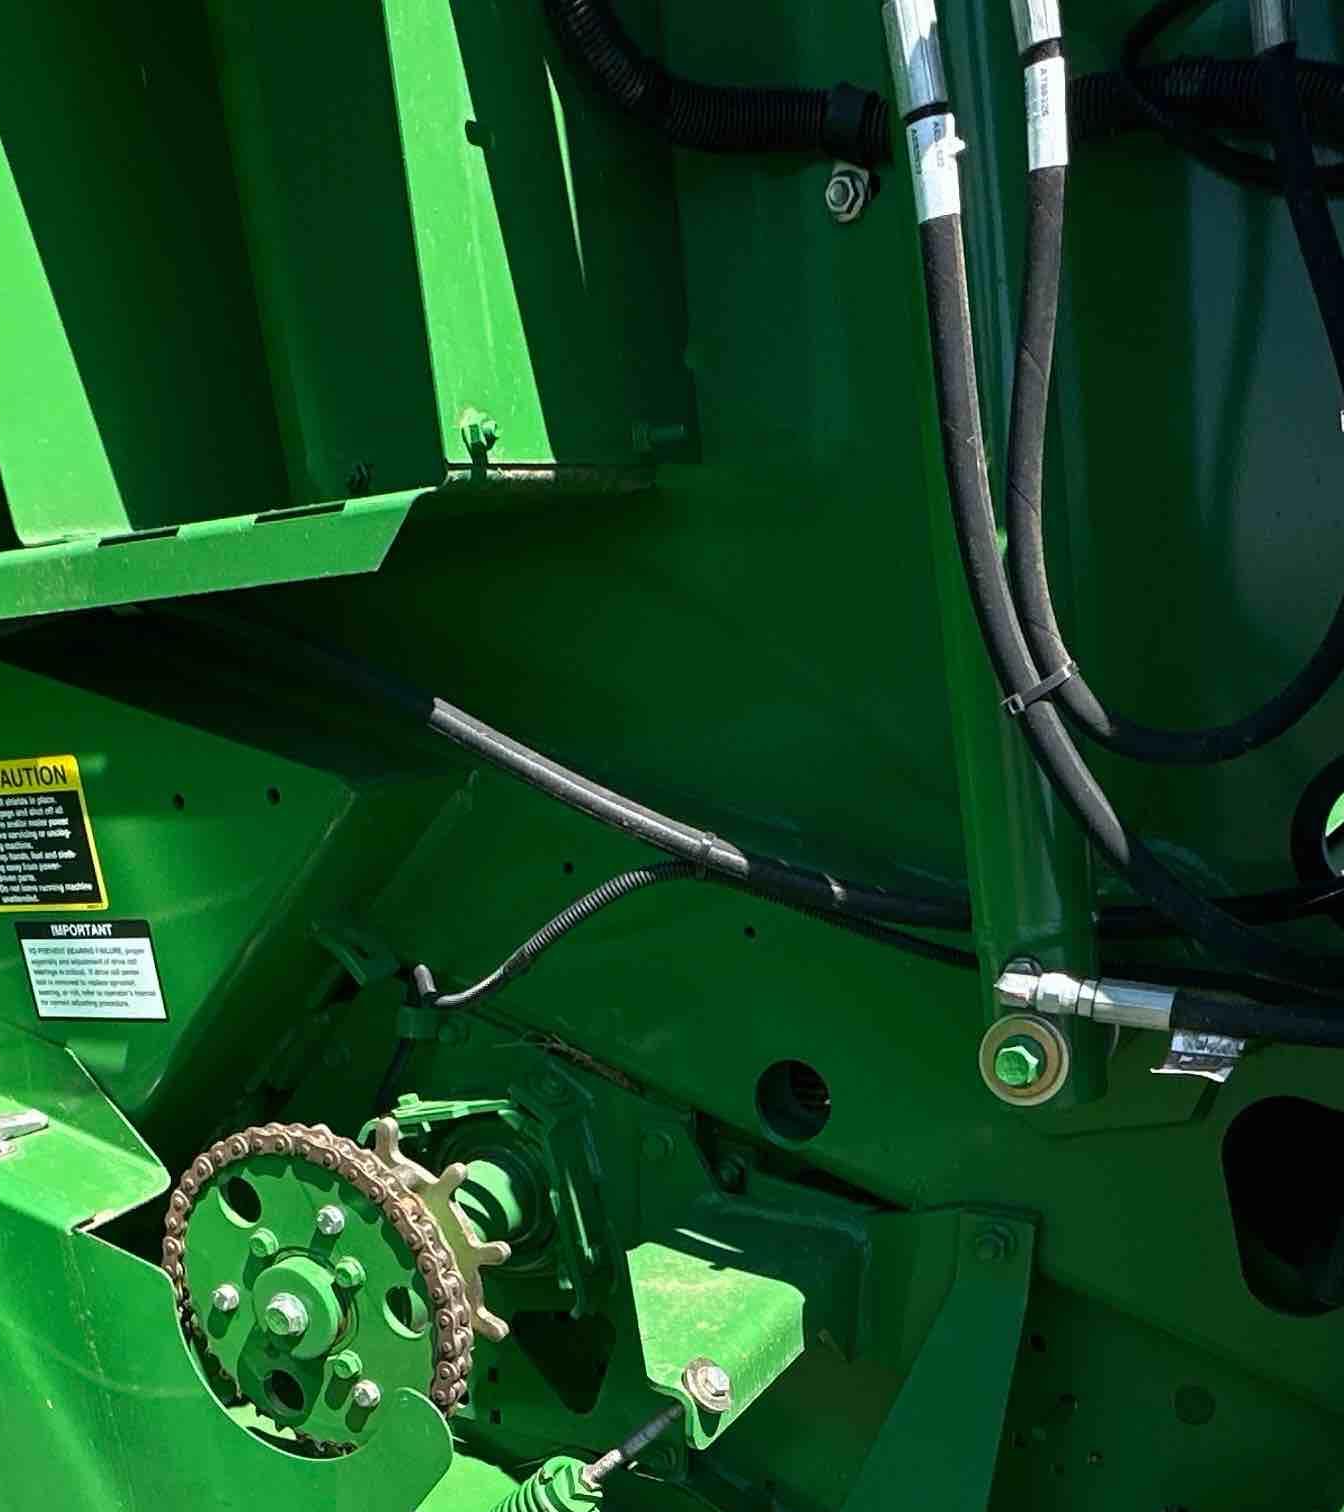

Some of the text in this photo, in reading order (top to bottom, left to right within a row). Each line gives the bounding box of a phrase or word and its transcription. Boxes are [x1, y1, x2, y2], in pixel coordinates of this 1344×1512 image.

[5, 796, 28, 807] shields
[36, 794, 56, 804] place.
[15, 808, 28, 818] and
[28, 807, 43, 817] shut
[44, 806, 54, 816] off
[54, 805, 64, 815] all
[47, 817, 69, 827] power
[7, 830, 38, 841] servicing
[44, 850, 57, 860] and
[5, 863, 22, 872] away
[22, 862, 38, 871] from
[38, 861, 62, 871] power-
[17, 873, 36, 881] parts.
[8, 884, 20, 894] not
[21, 884, 38, 893] leave
[38, 882, 64, 893] running
[64, 881, 93, 891] machine
[50, 924, 113, 936] IMPORTANT
